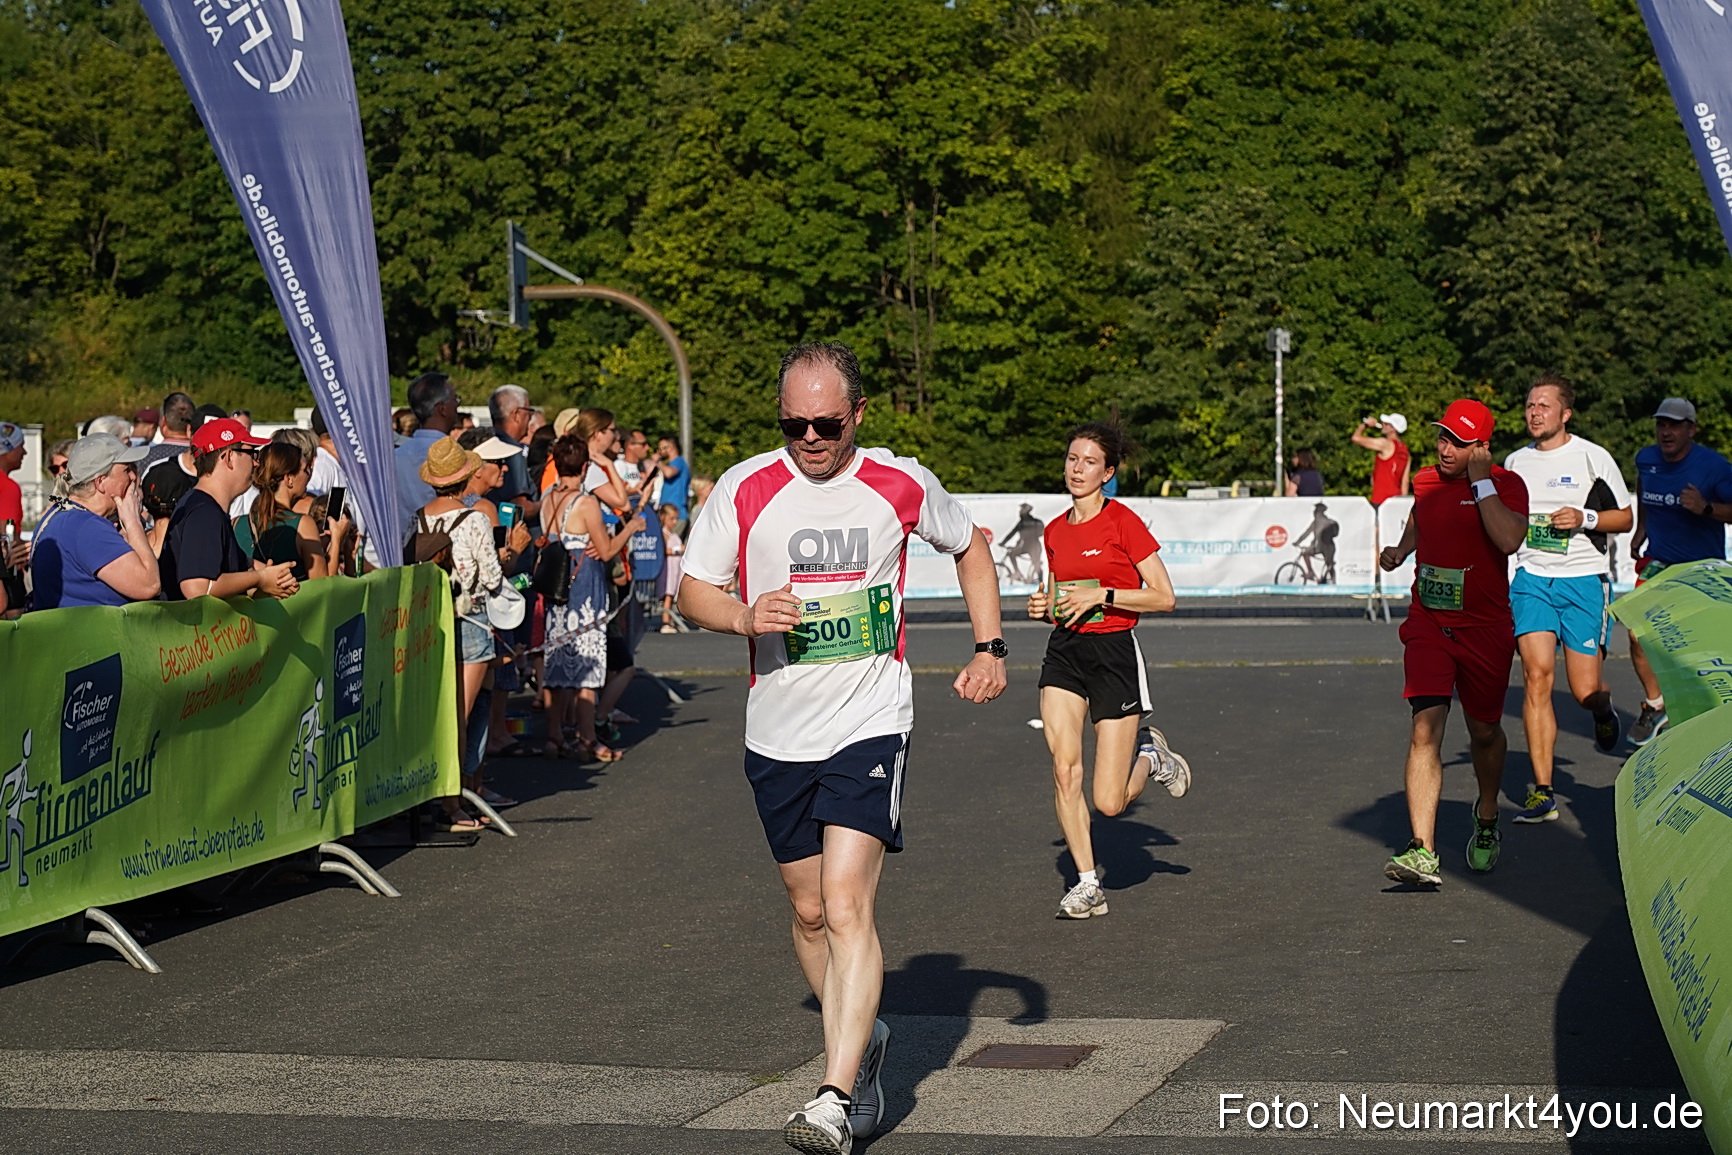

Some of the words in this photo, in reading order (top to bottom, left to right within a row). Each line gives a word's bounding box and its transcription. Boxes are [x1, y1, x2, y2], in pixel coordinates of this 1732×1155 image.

[788, 527, 869, 564] OM
[1535, 525, 1558, 539] 536
[1423, 578, 1454, 597] 1233
[804, 616, 851, 643] 500
[838, 637, 864, 650] Gerhard
[860, 616, 871, 648] 2022
[160, 624, 214, 683] Gesunde
[72, 694, 114, 722] Fischer
[75, 712, 107, 733] AUTOMOBILE
[36, 729, 160, 846] firmenlauf
[36, 831, 93, 876] neumarkt
[121, 811, 266, 880] www.firmenlauf-oberpfalz.de
